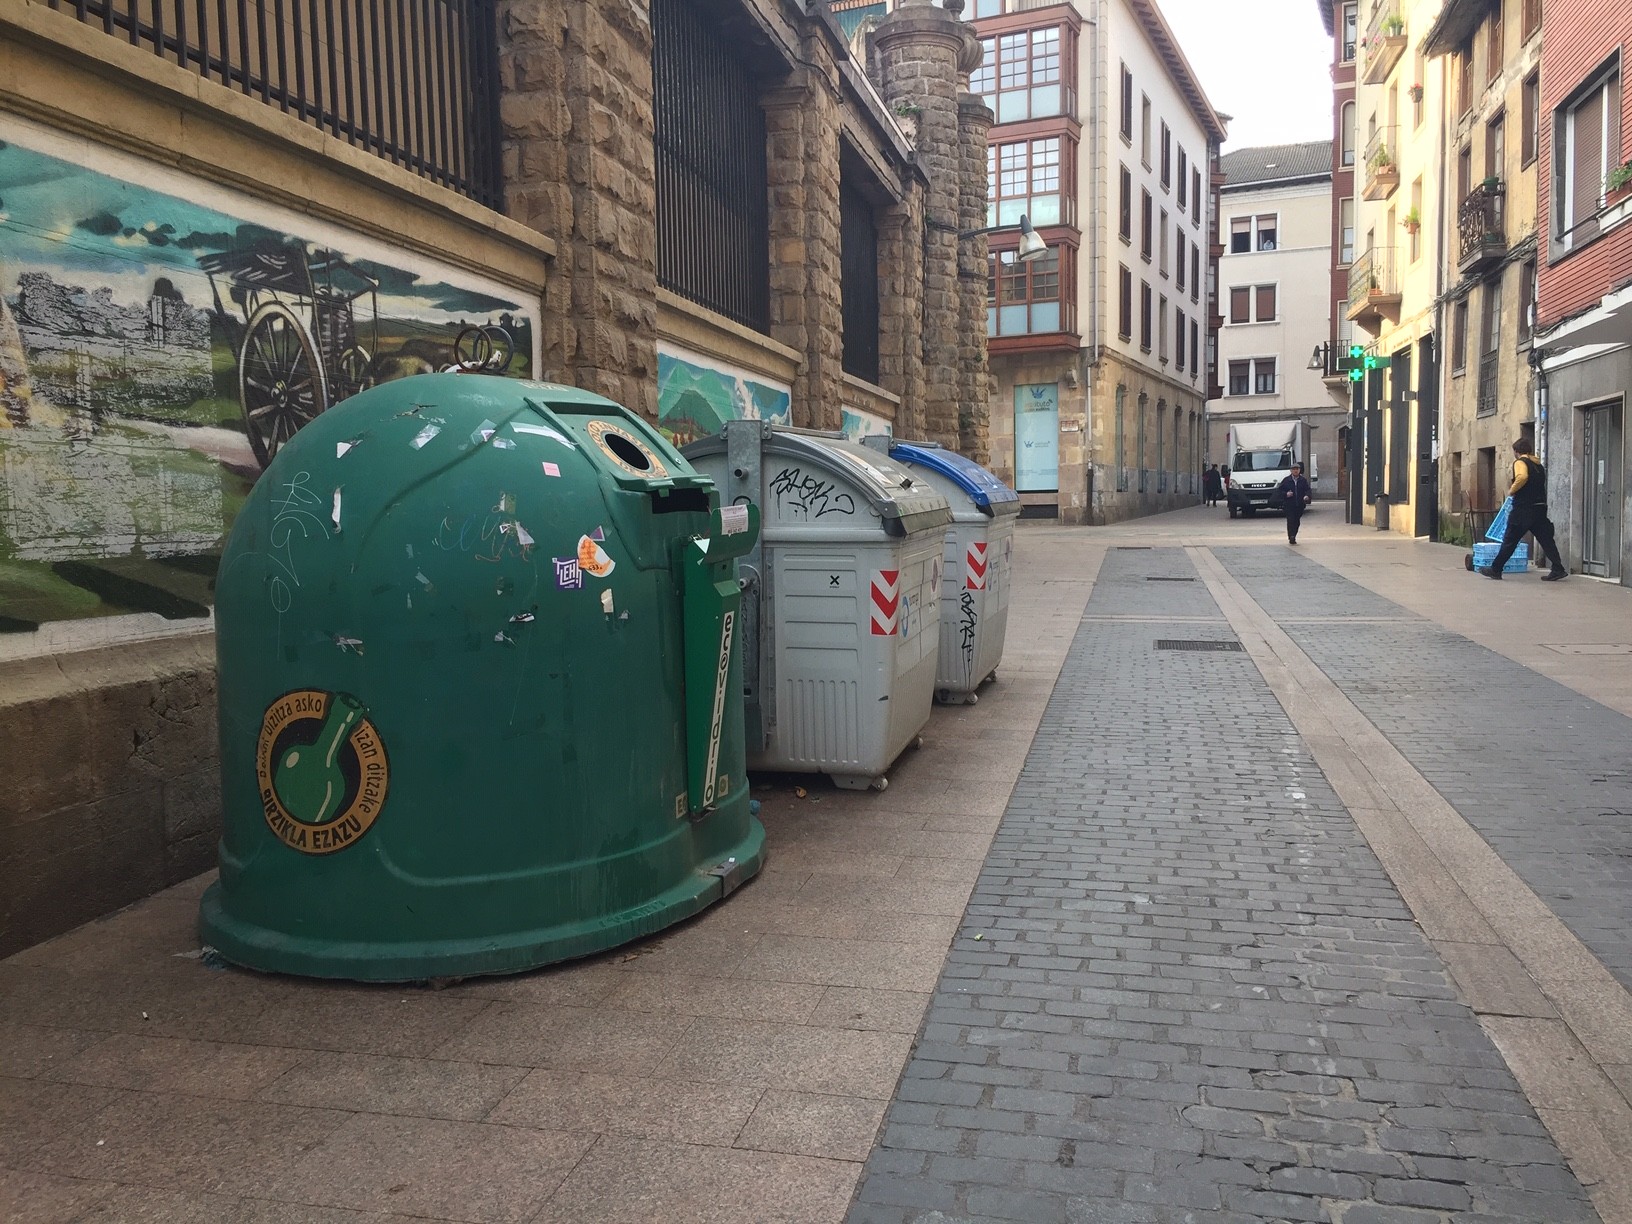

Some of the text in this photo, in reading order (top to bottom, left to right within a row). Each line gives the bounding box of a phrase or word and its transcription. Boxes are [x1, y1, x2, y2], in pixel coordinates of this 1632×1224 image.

[296, 694, 322, 713] asko
[706, 615, 732, 801] ecovidrio
[354, 726, 378, 758] izan
[358, 763, 385, 814] ditzake
[262, 788, 362, 849] BIRZIKLA EZAZU
